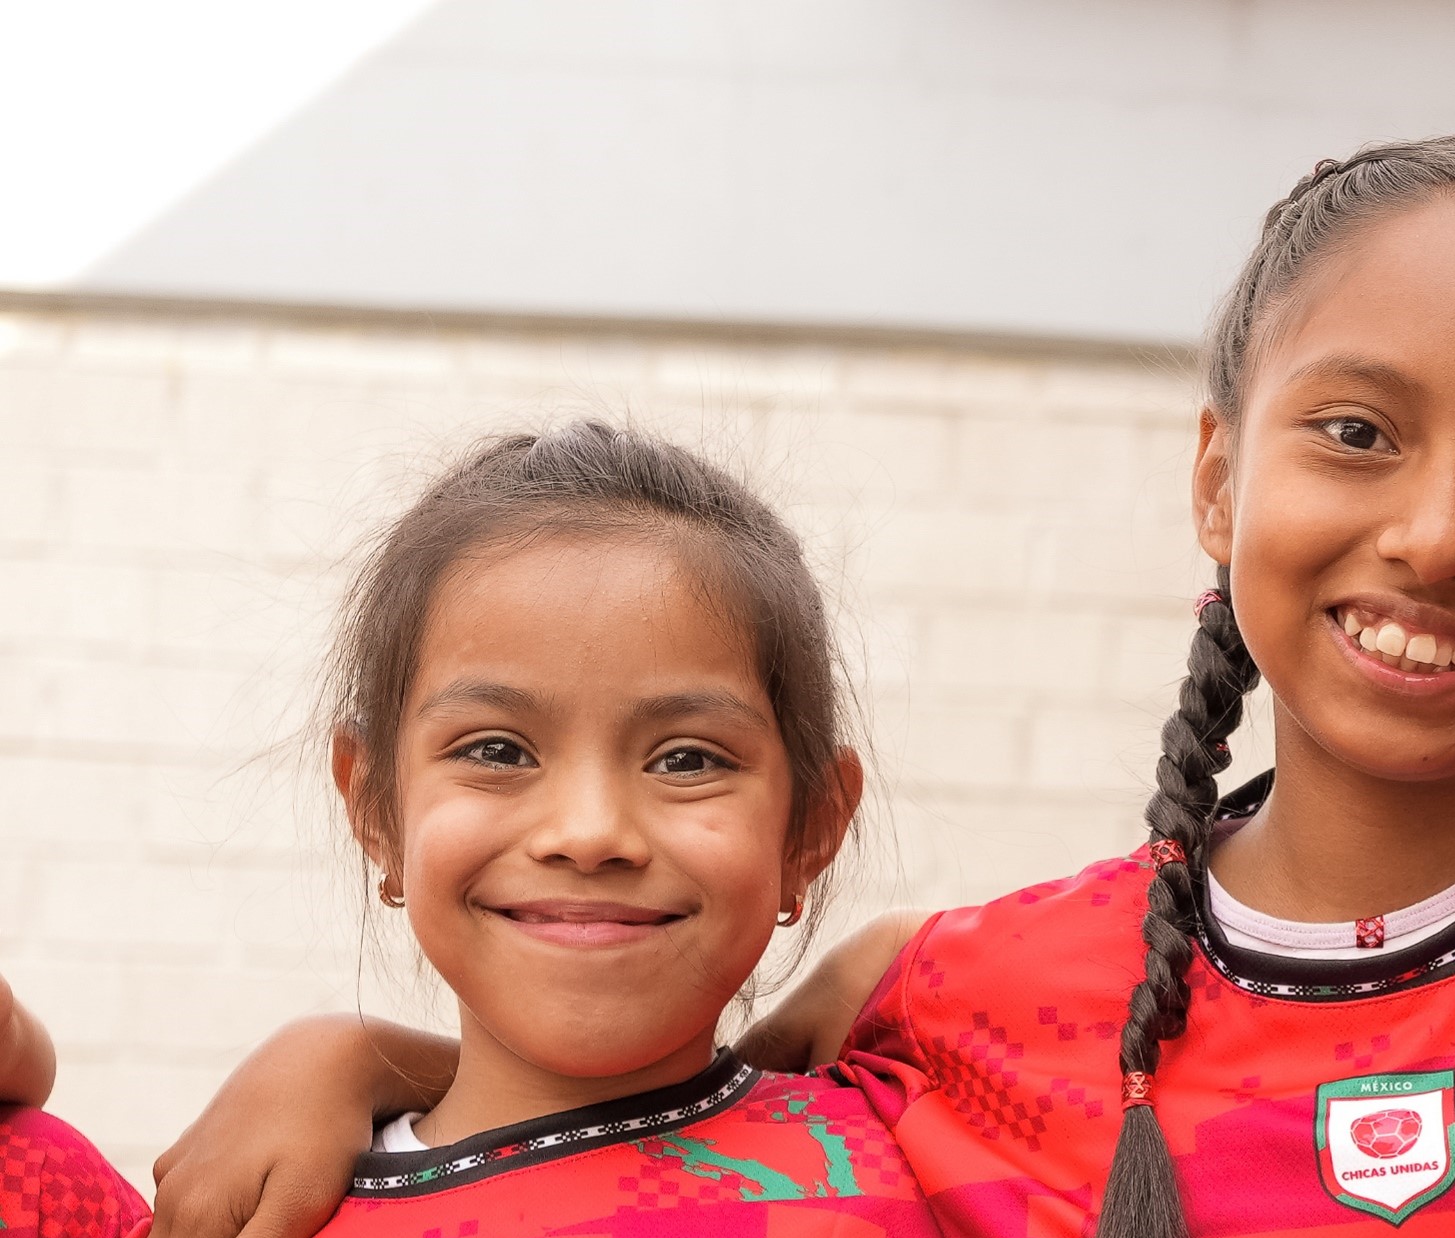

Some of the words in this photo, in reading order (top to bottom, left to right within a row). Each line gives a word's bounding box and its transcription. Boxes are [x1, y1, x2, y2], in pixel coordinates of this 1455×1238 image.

[1360, 1081, 1413, 1092] MÉXICO
[1341, 1167, 1386, 1181] CHICAS
[1390, 1161, 1439, 1175] UNIDAS
